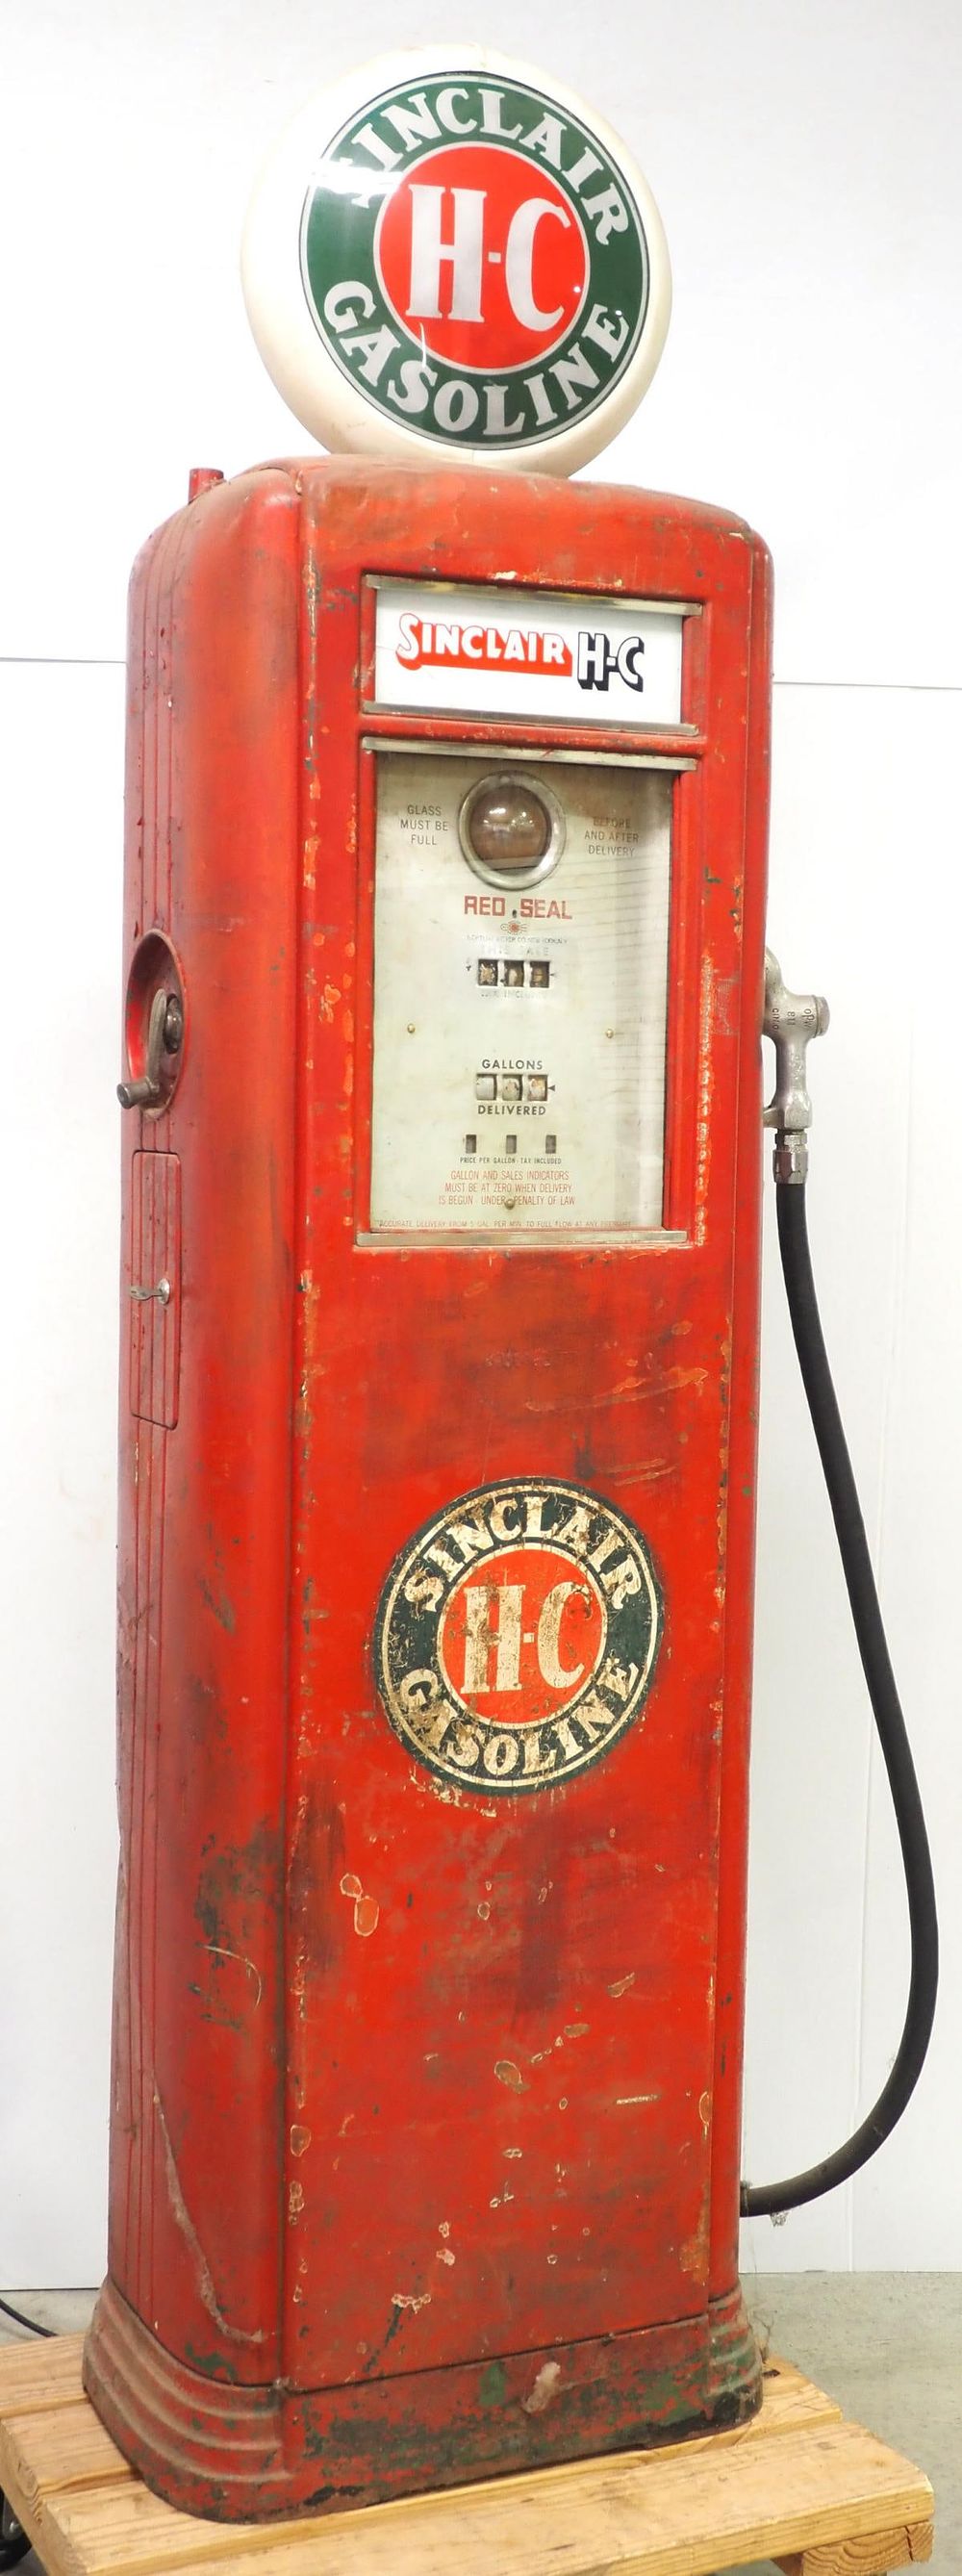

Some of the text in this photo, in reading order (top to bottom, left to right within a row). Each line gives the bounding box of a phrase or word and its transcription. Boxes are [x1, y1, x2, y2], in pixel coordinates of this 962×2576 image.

[405, 184, 571, 332] H-C
[323, 280, 630, 436] GASOLINE
[395, 613, 645, 692] SINCLAIR H-C
[407, 804, 442, 816] GLASS
[400, 819, 449, 831] MUST BE
[411, 833, 437, 846] FULL
[584, 829, 640, 844] AND AFTER
[588, 845, 635, 856] DELIVERY
[464, 895, 572, 920] RED SEAL
[481, 1058, 544, 1070] GALLONS
[477, 1105, 546, 1116] DELIVERED
[451, 1170, 570, 1181] GALLON AND SALES INDICATORS
[445, 1183, 572, 1193] MUST BE AT ZERO WHEN DELIVERY
[439, 1195, 575, 1206] IS BEGUN UNDER PENALTY OF LAW
[403, 1496, 643, 1614] SINCLAIR
[461, 1581, 592, 1695] H-C
[399, 1656, 639, 1775] GASOLINE
